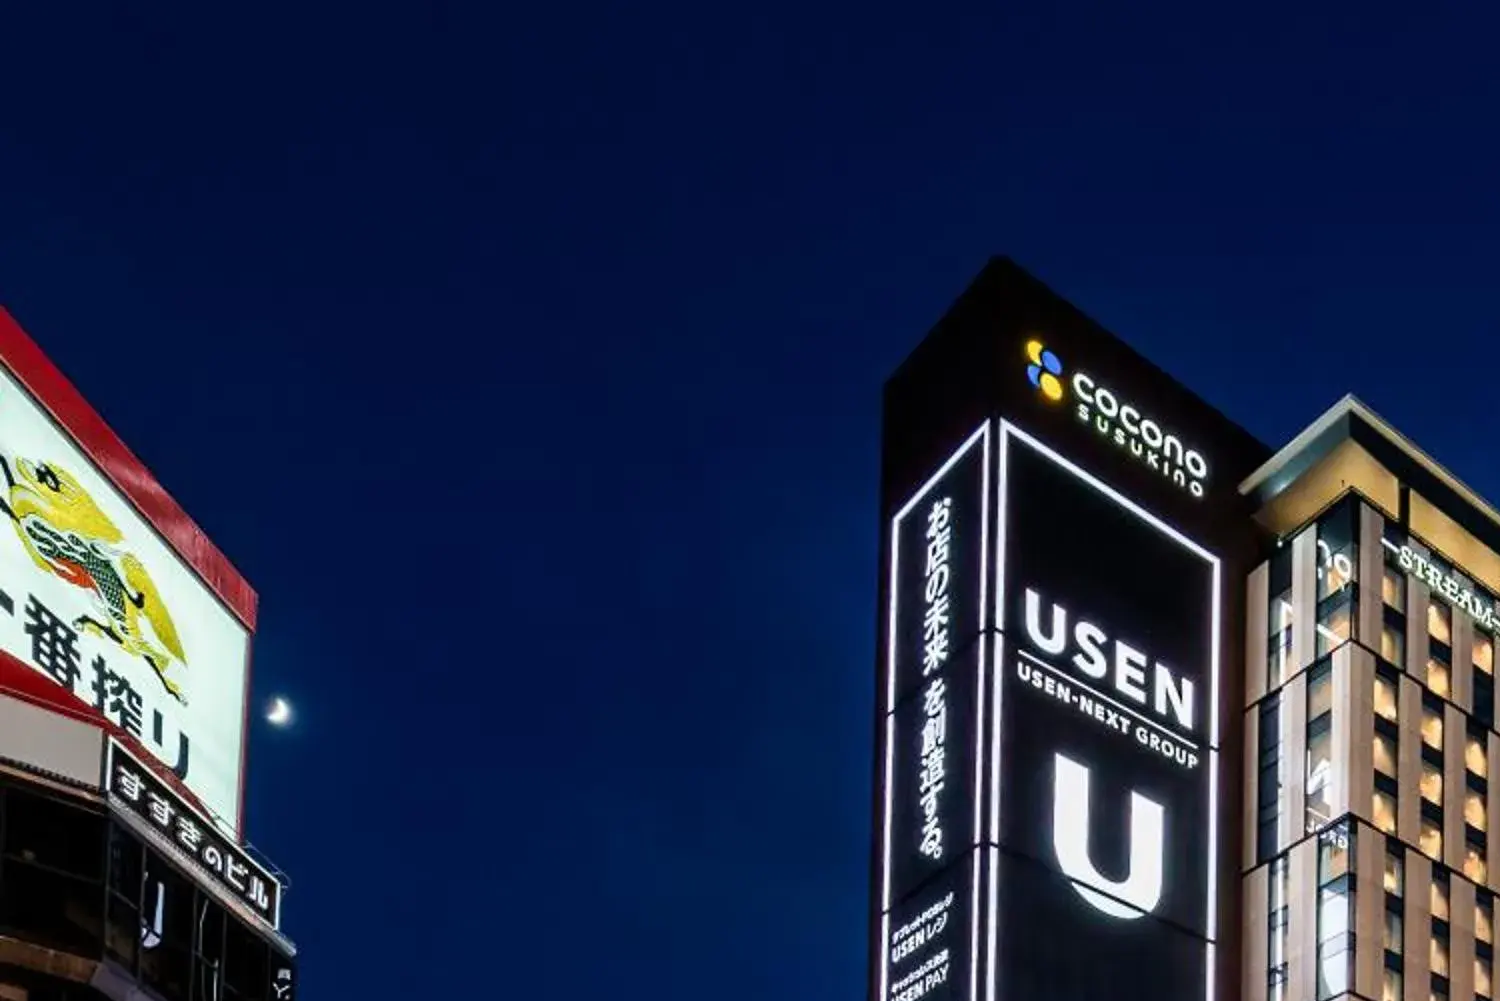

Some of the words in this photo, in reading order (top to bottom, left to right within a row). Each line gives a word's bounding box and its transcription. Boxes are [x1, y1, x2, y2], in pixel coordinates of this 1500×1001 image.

[0, 590, 190, 782] 番搾り
[1016, 662, 1132, 737] USEN-NEXT
[1136, 726, 1199, 770] GROUP
[1024, 587, 1194, 730] USEN
[117, 764, 269, 911] すすきのビル
[1053, 753, 1165, 920] U
[892, 928, 925, 964] USEN
[925, 962, 949, 992] PAY
